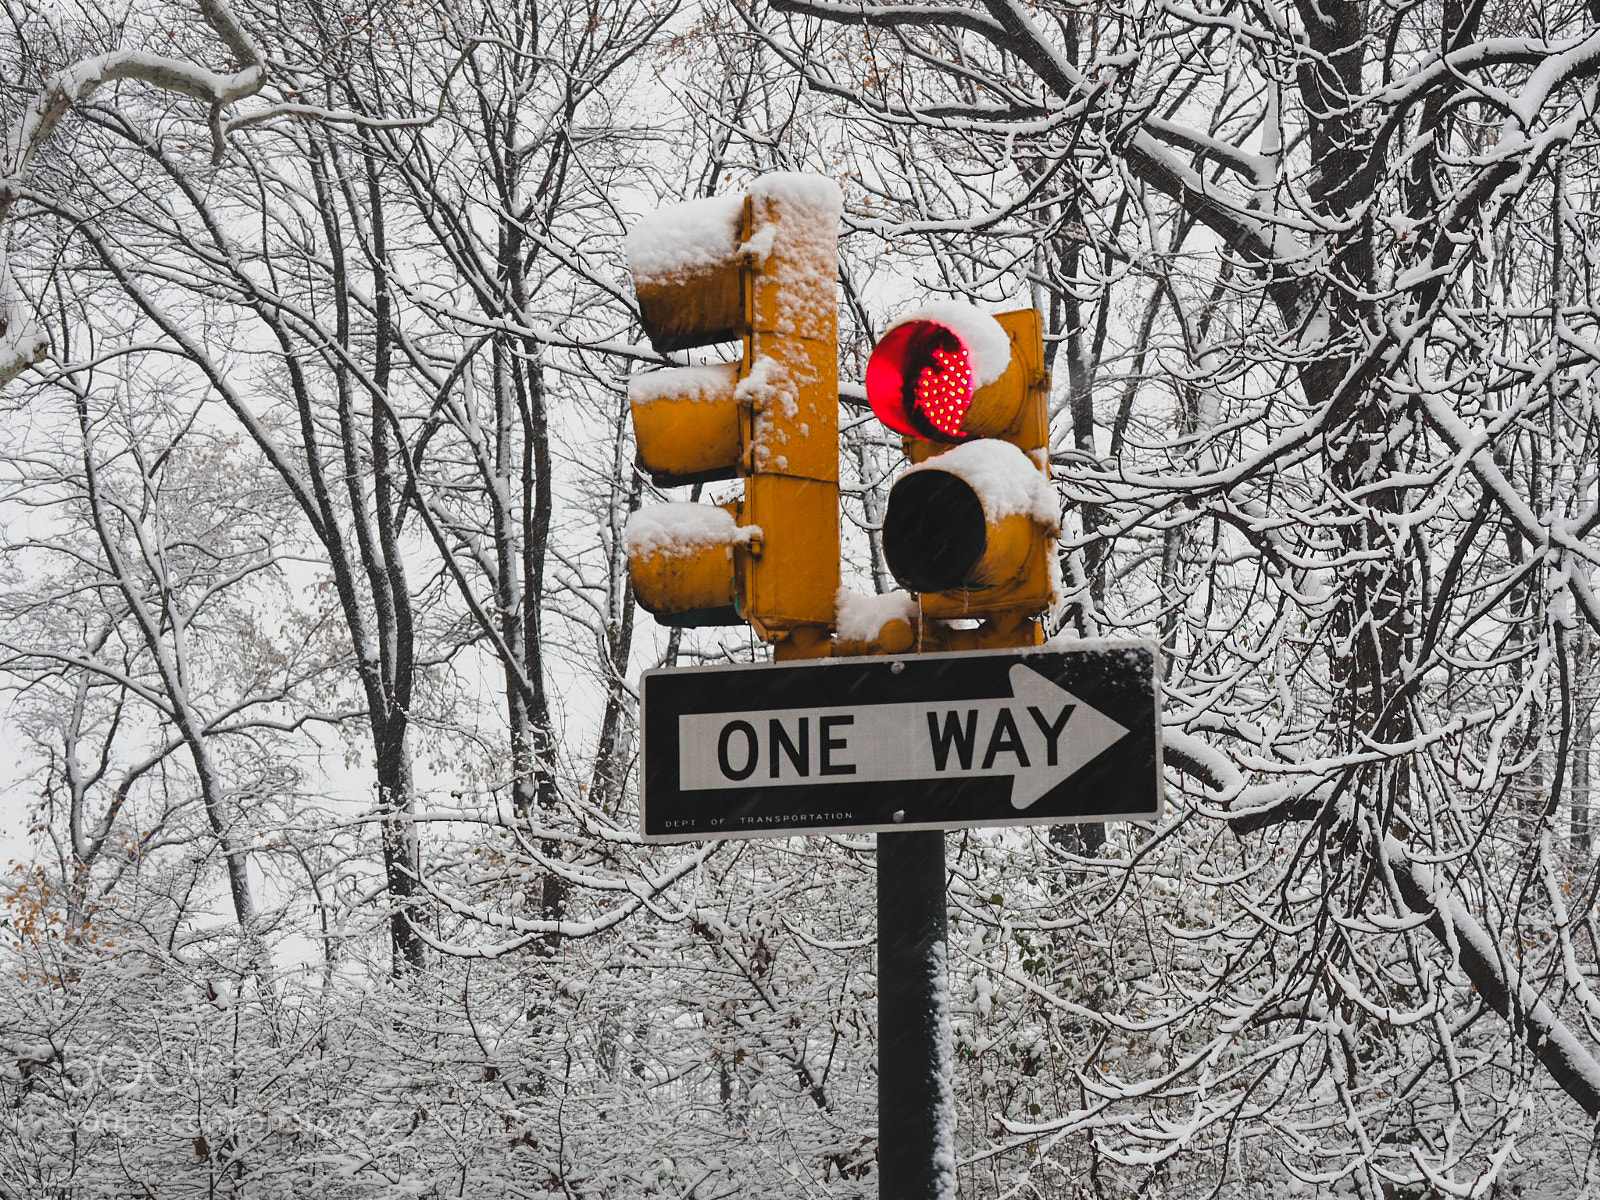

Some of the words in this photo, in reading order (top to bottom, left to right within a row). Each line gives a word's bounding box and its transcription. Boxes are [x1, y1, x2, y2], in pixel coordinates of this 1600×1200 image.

[717, 714, 858, 782] ONE
[926, 704, 1077, 772] WAY
[665, 820, 696, 828] DEPT
[711, 818, 726, 826] OF
[740, 812, 853, 824] TRANSPORTATION
